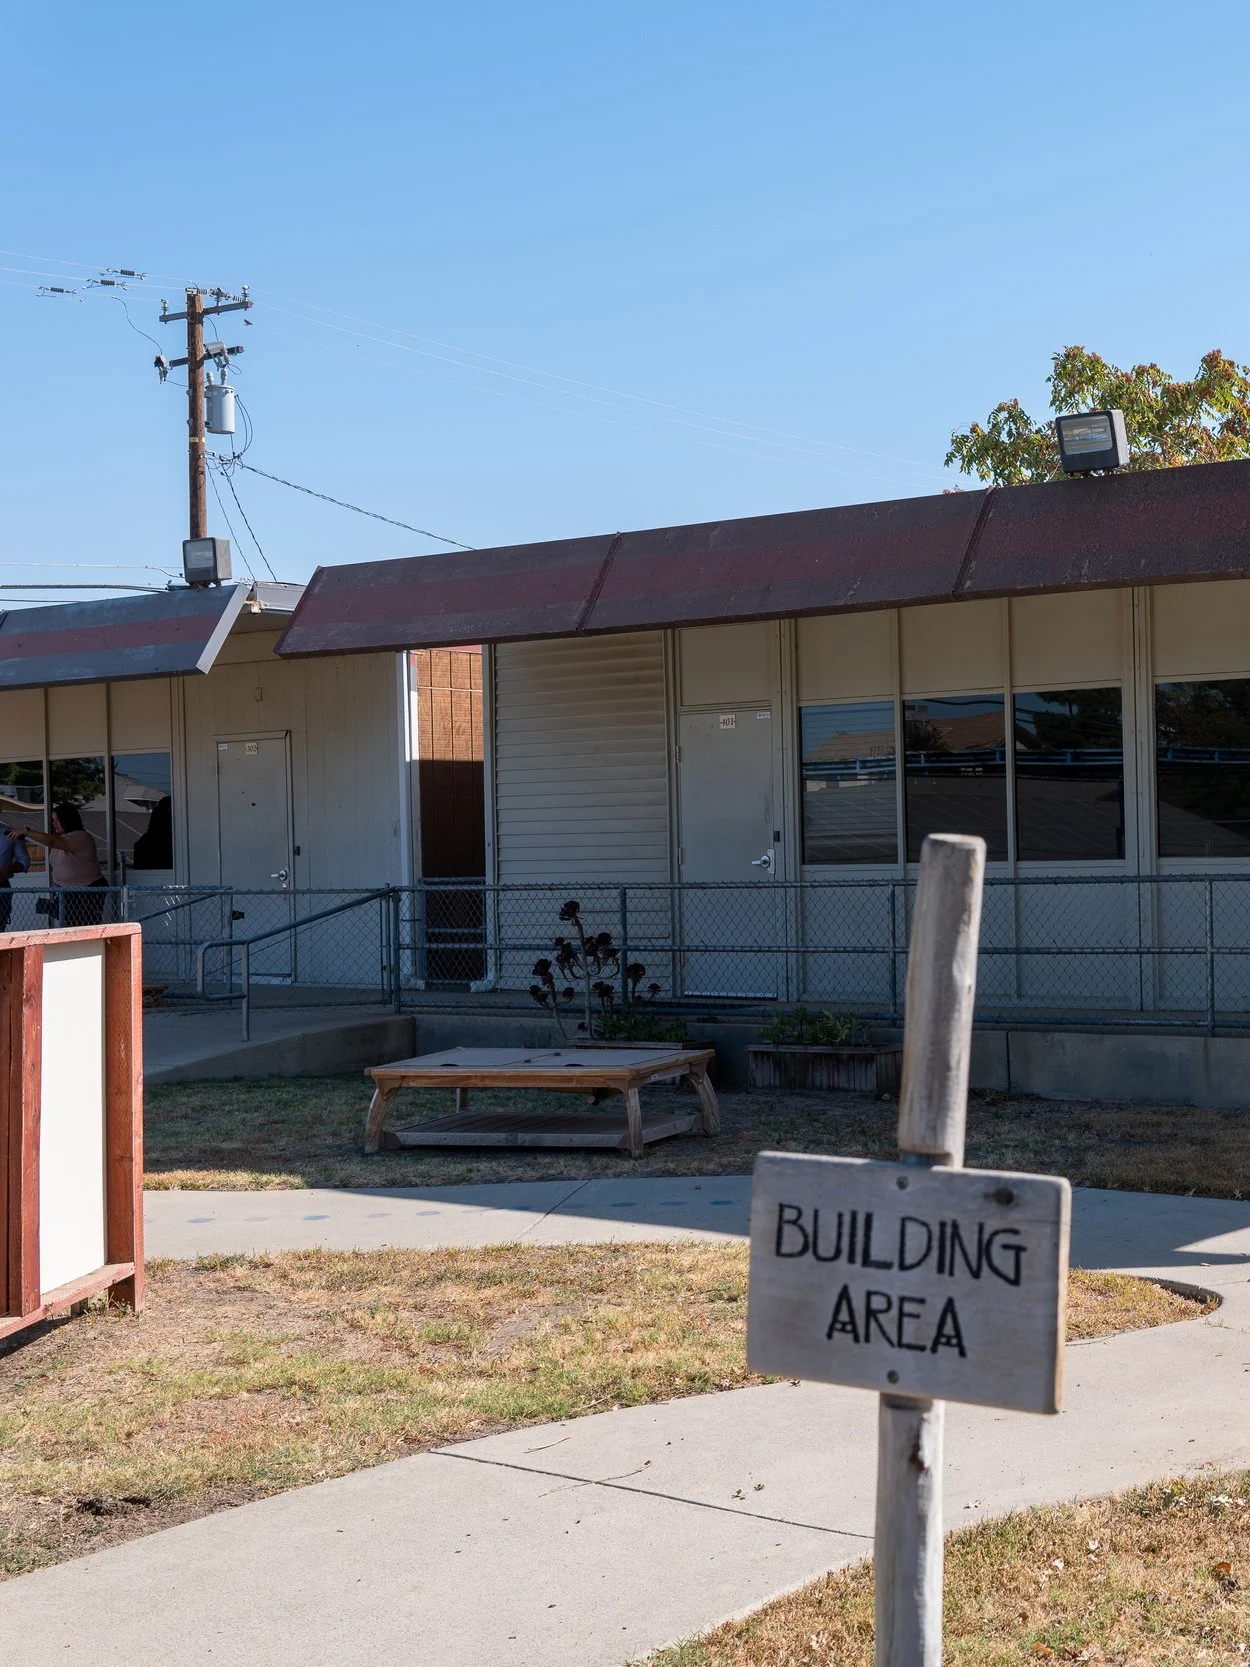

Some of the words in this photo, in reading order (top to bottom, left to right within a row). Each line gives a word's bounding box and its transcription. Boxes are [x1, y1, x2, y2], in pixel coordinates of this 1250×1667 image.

[721, 718, 734, 726] 401
[775, 1202, 1028, 1287] BUILDING
[826, 1283, 967, 1359] AREA
